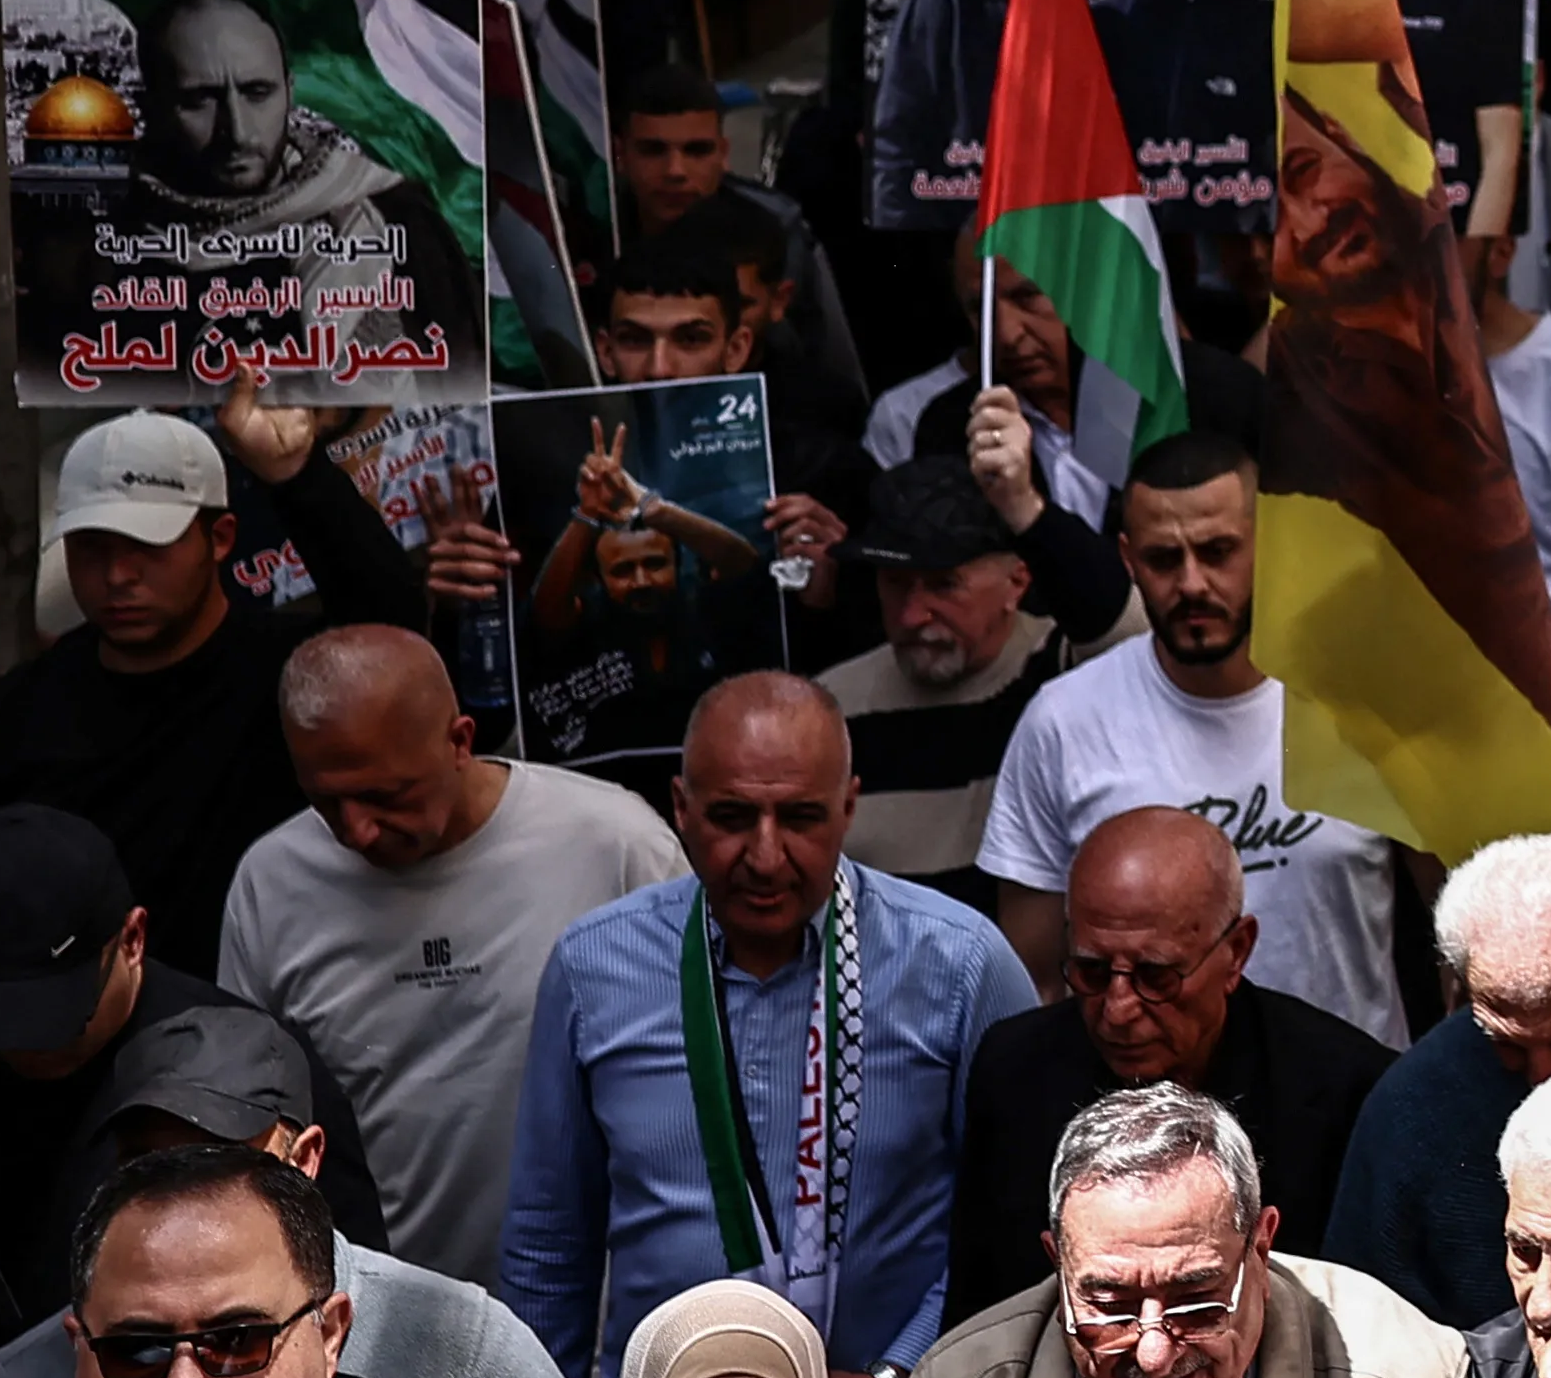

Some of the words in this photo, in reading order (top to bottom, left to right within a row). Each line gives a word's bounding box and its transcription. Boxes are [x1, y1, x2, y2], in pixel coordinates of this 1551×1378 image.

[94, 222, 190, 266] الحرية
[198, 222, 305, 266] لأسرى
[313, 222, 409, 266] الحرية
[91, 275, 190, 315] القائد
[198, 275, 303, 321] الرفيق
[312, 271, 417, 319] الأسير
[716, 392, 759, 425] 24
[423, 938, 451, 968] BIG
